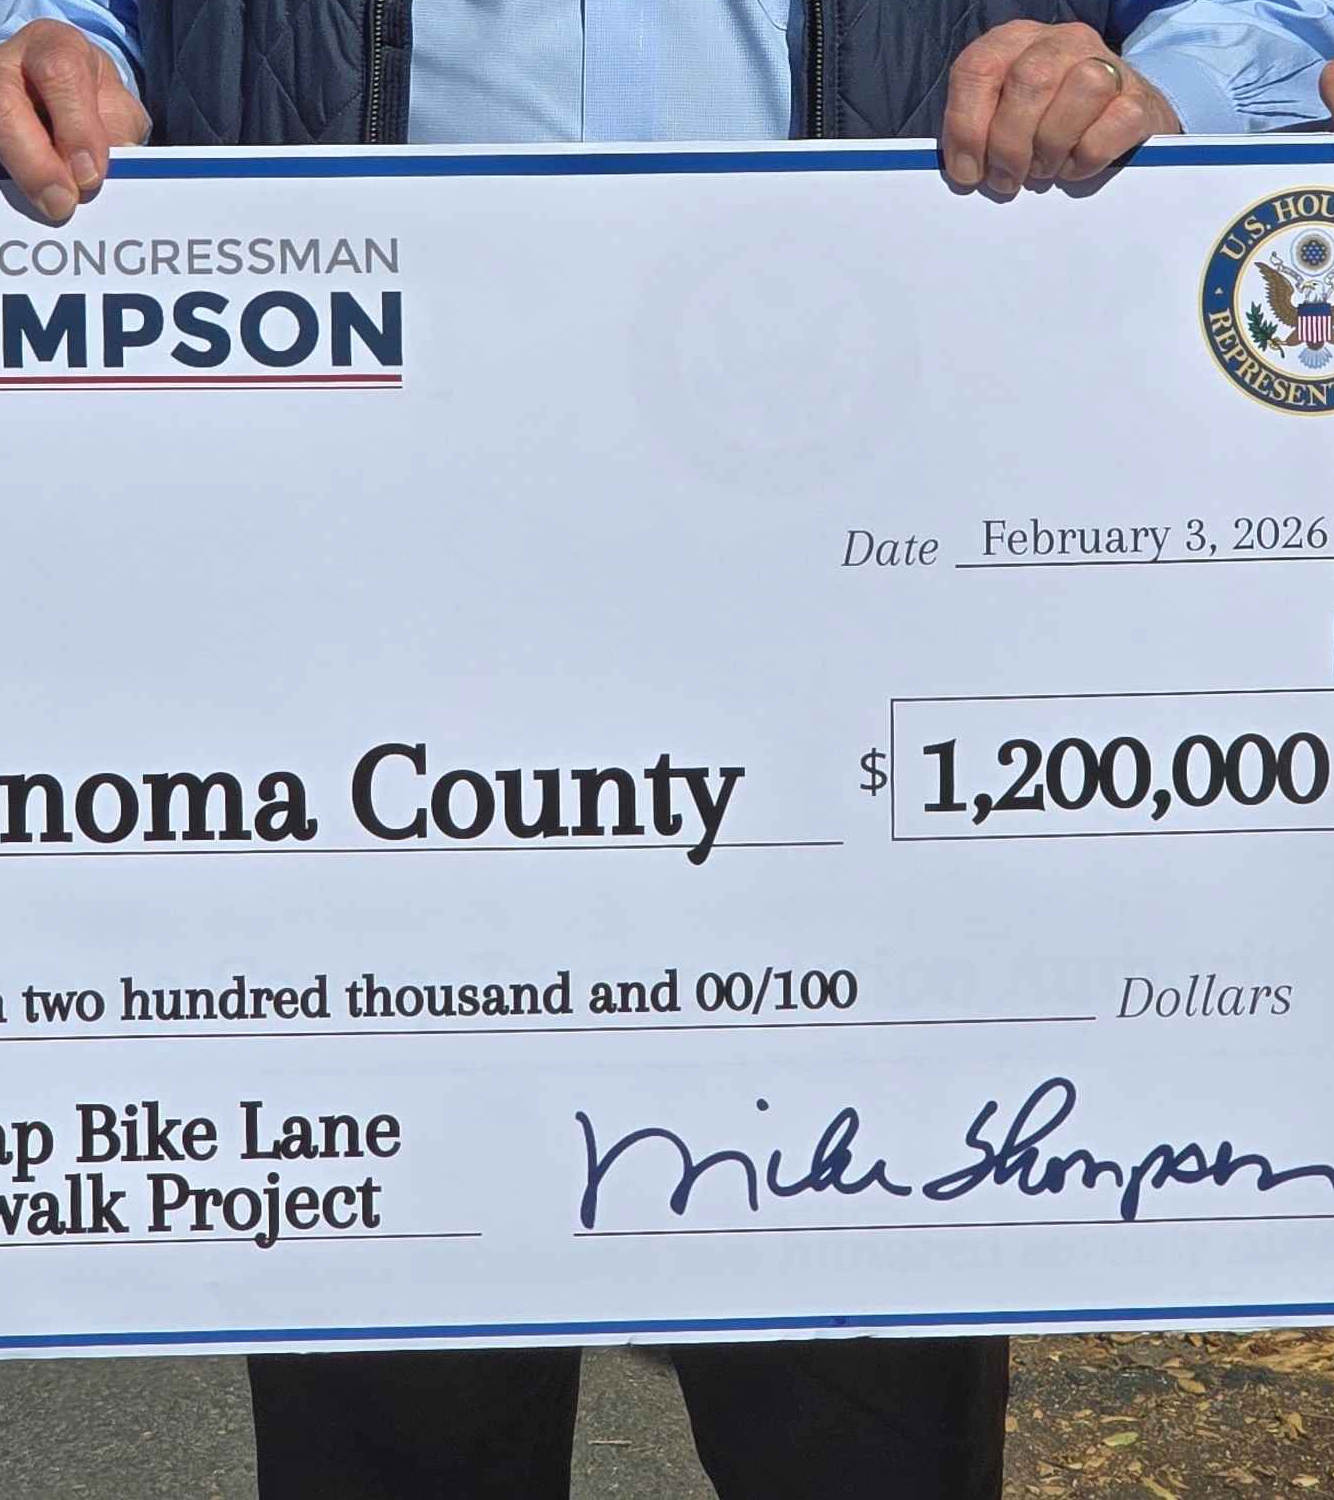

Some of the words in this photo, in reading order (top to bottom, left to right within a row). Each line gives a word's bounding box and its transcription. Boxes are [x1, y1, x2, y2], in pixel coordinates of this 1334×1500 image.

[1219, 216, 1272, 262] U.S.
[840, 529, 940, 568] Date
[981, 517, 1172, 564] February
[1184, 517, 1218, 557] 3,
[1232, 515, 1329, 551] 2026
[351, 742, 746, 866] County
[859, 747, 889, 797] $
[922, 731, 1331, 826] 1,200,000
[21, 984, 106, 1024] two
[119, 973, 332, 1021] hundred
[344, 969, 574, 1019] thousand
[588, 967, 682, 1015] and
[695, 966, 858, 1016] 00/100
[1115, 973, 1294, 1019] Dollars
[75, 1099, 219, 1164] Bike
[239, 1099, 403, 1161] Lane
[146, 1170, 384, 1250] Project
